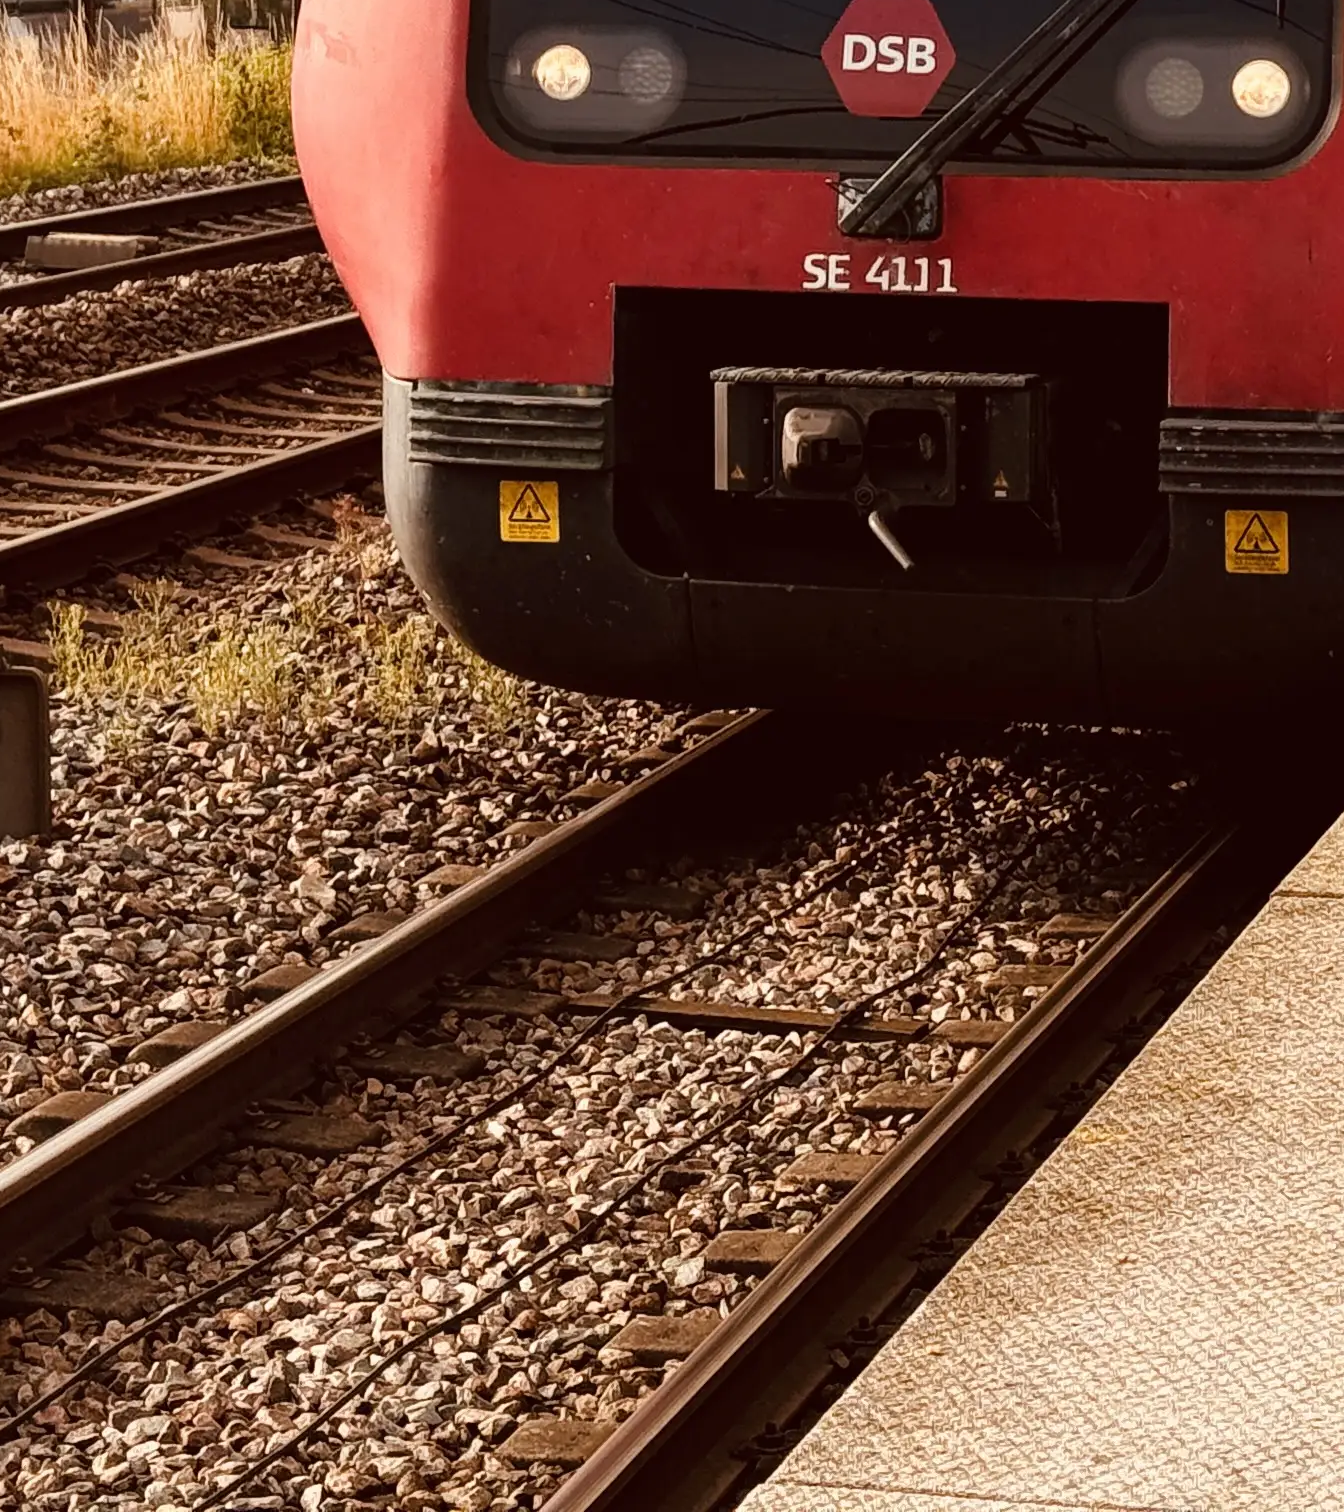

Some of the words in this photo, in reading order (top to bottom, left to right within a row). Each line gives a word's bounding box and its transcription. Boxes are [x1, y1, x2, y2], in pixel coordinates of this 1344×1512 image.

[842, 33, 937, 75] DSB
[802, 253, 851, 291] SE
[864, 255, 958, 293] 4111
